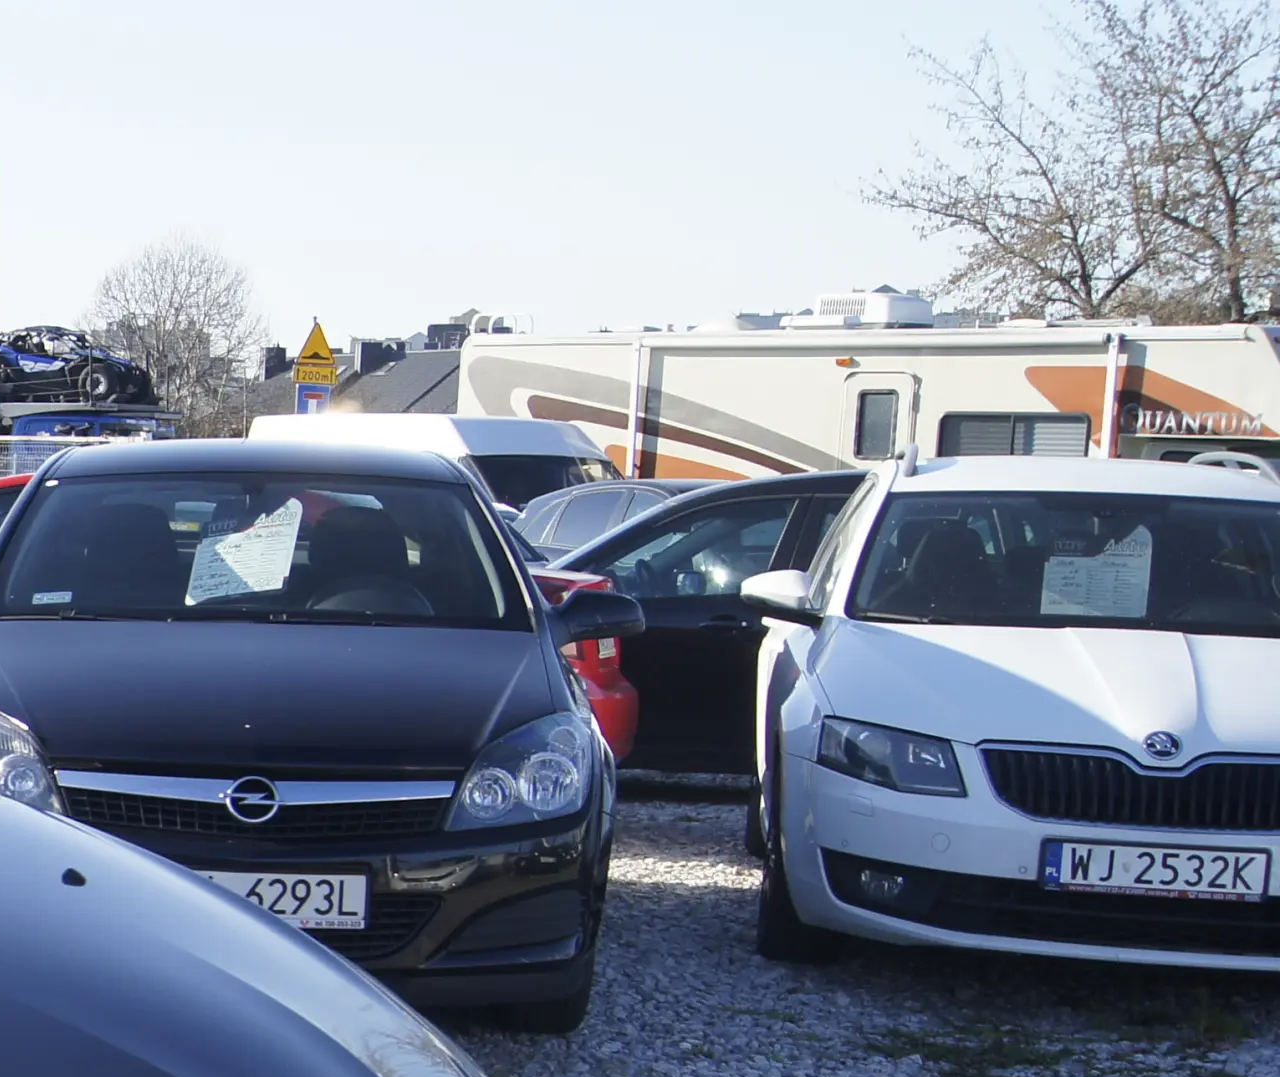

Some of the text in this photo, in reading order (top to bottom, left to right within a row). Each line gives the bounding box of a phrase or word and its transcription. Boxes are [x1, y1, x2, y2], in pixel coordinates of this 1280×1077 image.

[1121, 403, 1263, 436] QUANTUM
[1045, 866, 1059, 877] PL
[1070, 847, 1258, 891] WJ 2532K
